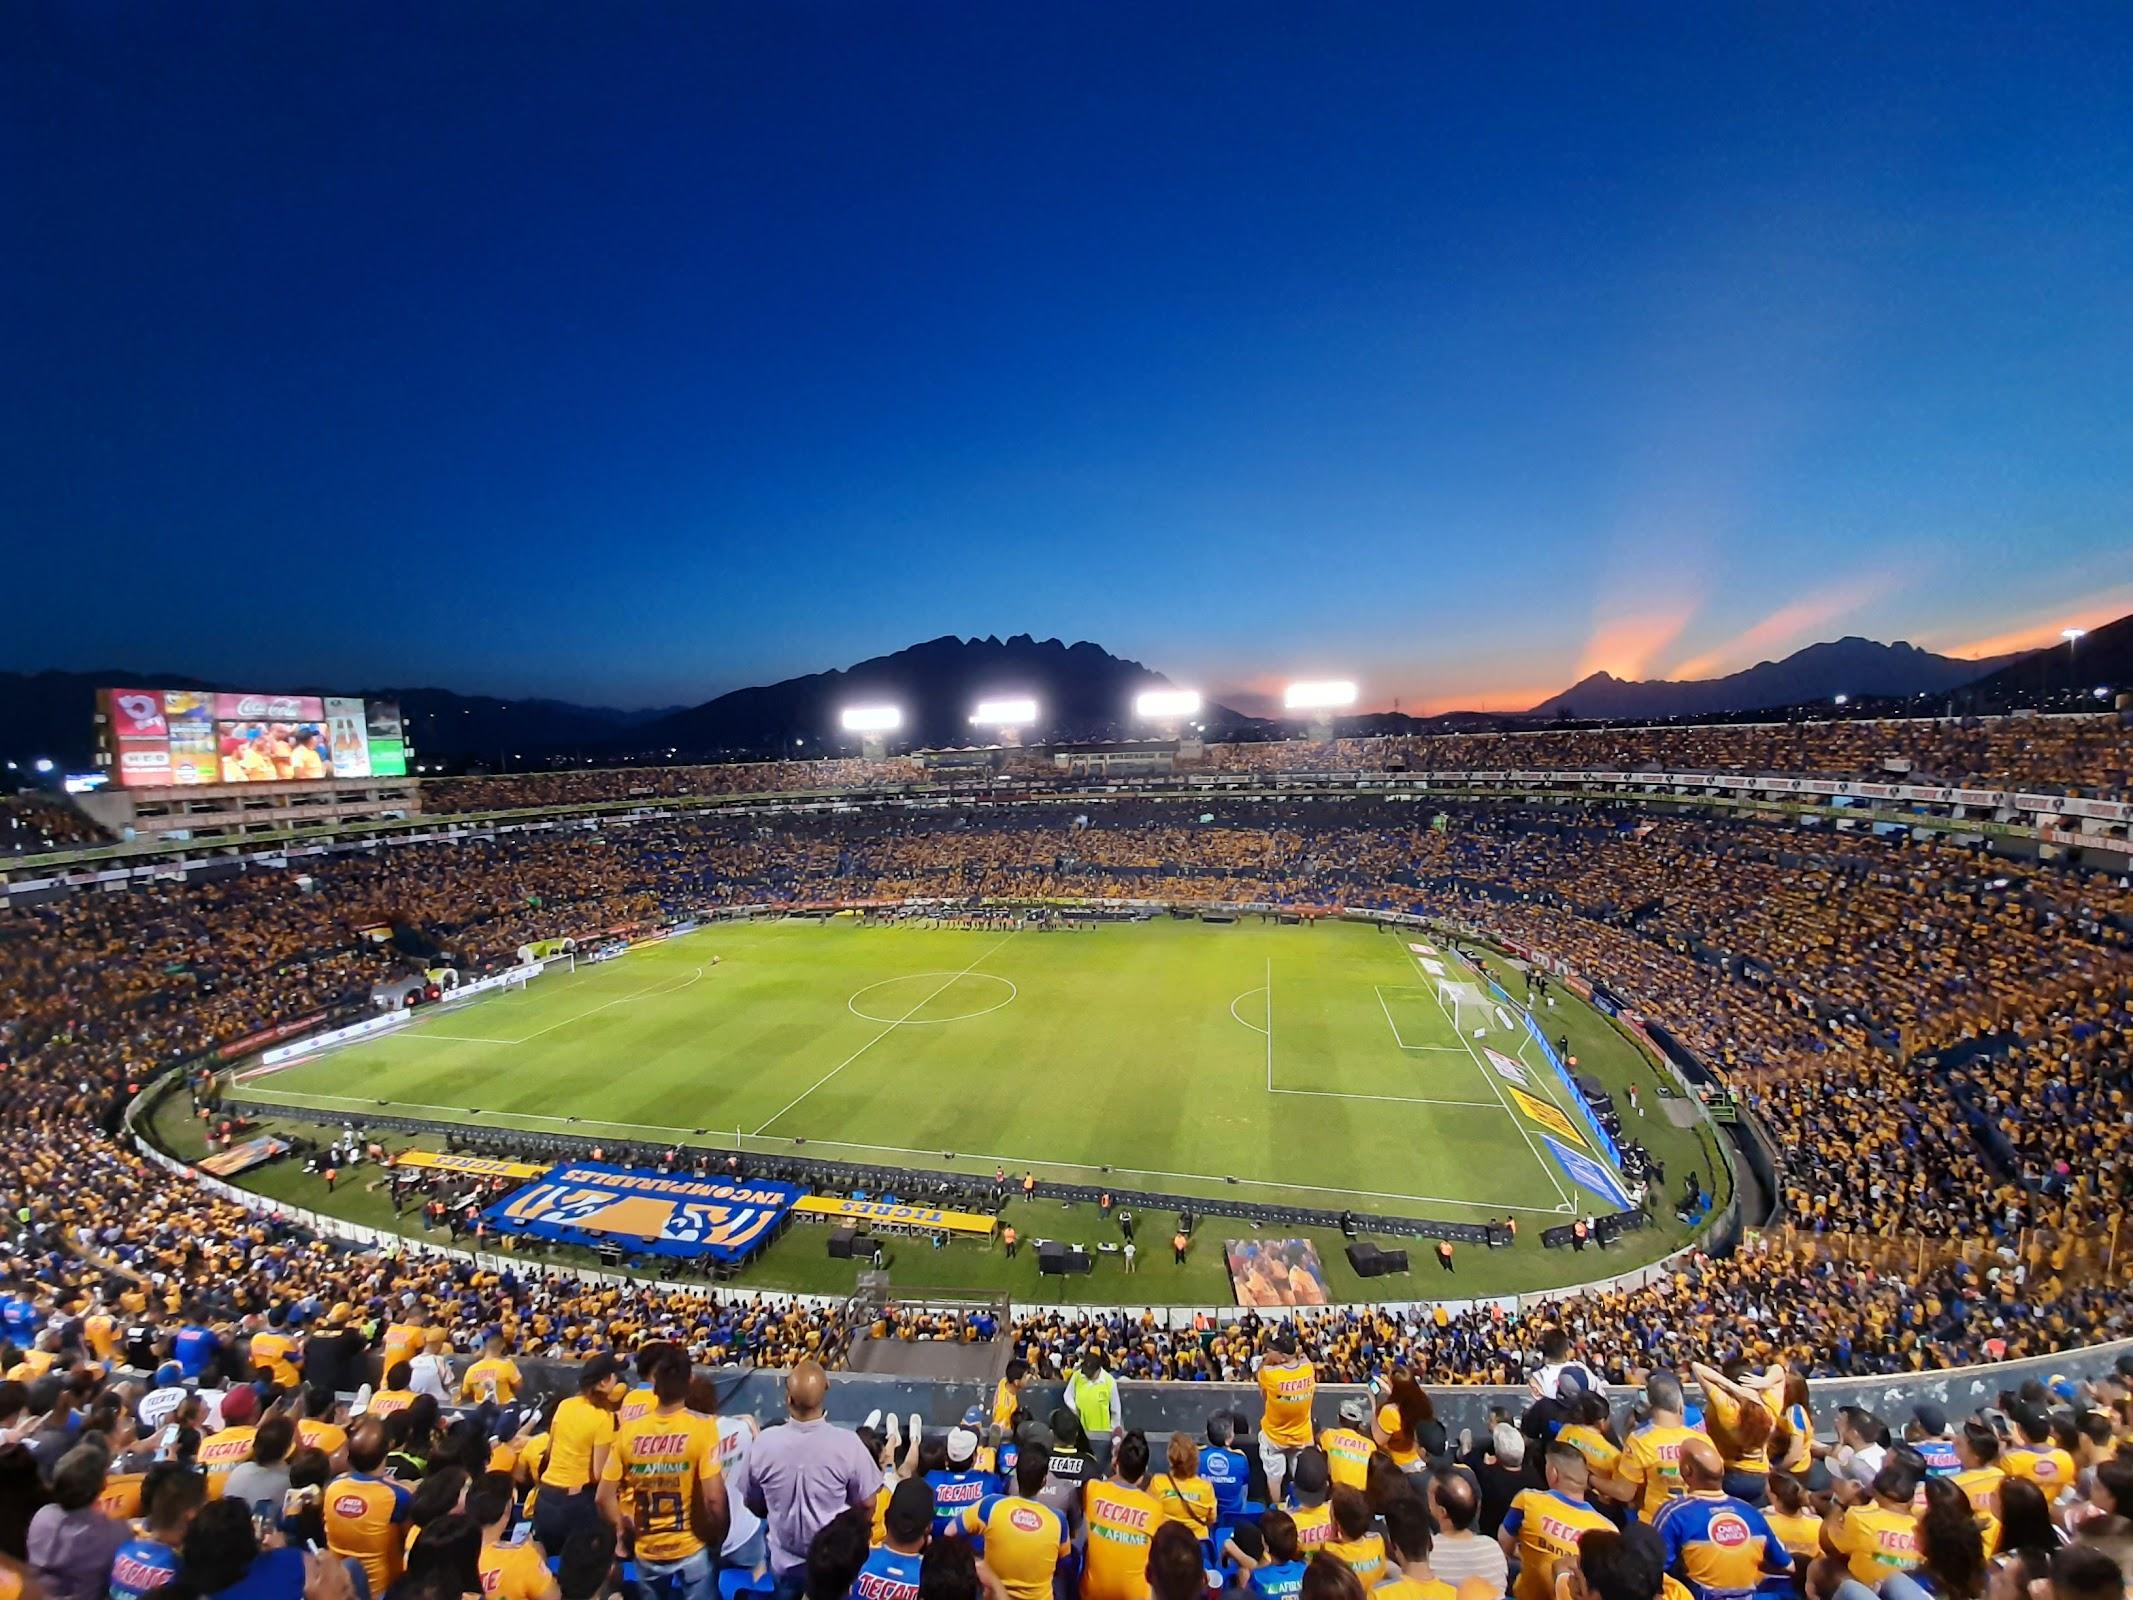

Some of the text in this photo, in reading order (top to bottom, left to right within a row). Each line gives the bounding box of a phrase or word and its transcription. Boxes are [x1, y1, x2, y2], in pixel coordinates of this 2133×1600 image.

[432, 1156, 510, 1172] TIGRES
[560, 1169, 785, 1204] INCOMPARABLES
[841, 1202, 943, 1222] TIGRES
[1280, 1379, 1312, 1392] TECATE
[202, 1439, 252, 1458] TECATE
[633, 1434, 688, 1456] TECATE
[1335, 1435, 1367, 1451] TECATE
[1658, 1446, 1681, 1460] TEC
[1049, 1456, 1084, 1473] ECATE
[936, 1481, 983, 1502] TECATE
[1096, 1499, 1149, 1528] TECATE
[1105, 1527, 1147, 1545] AFIRME
[1301, 1524, 1332, 1543] TECA
[1542, 1517, 1581, 1543] TECA
[1879, 1530, 1917, 1549] TECA
[859, 1573, 920, 1600] TECAT
